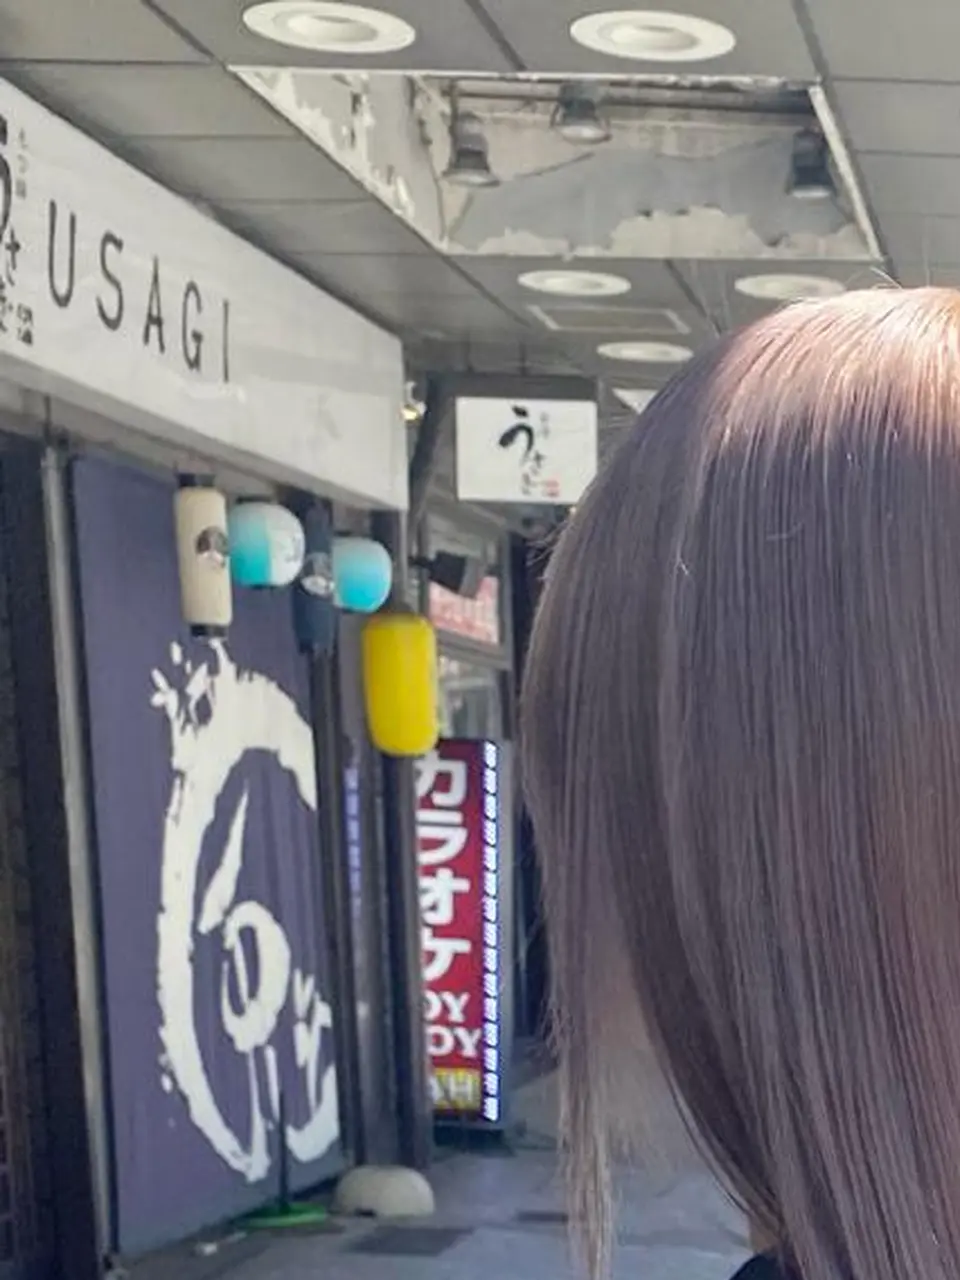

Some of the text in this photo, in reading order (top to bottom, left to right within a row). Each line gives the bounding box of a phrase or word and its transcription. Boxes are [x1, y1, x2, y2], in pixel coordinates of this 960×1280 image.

[48, 199, 230, 384] USAGI
[414, 748, 471, 983] カラオケ
